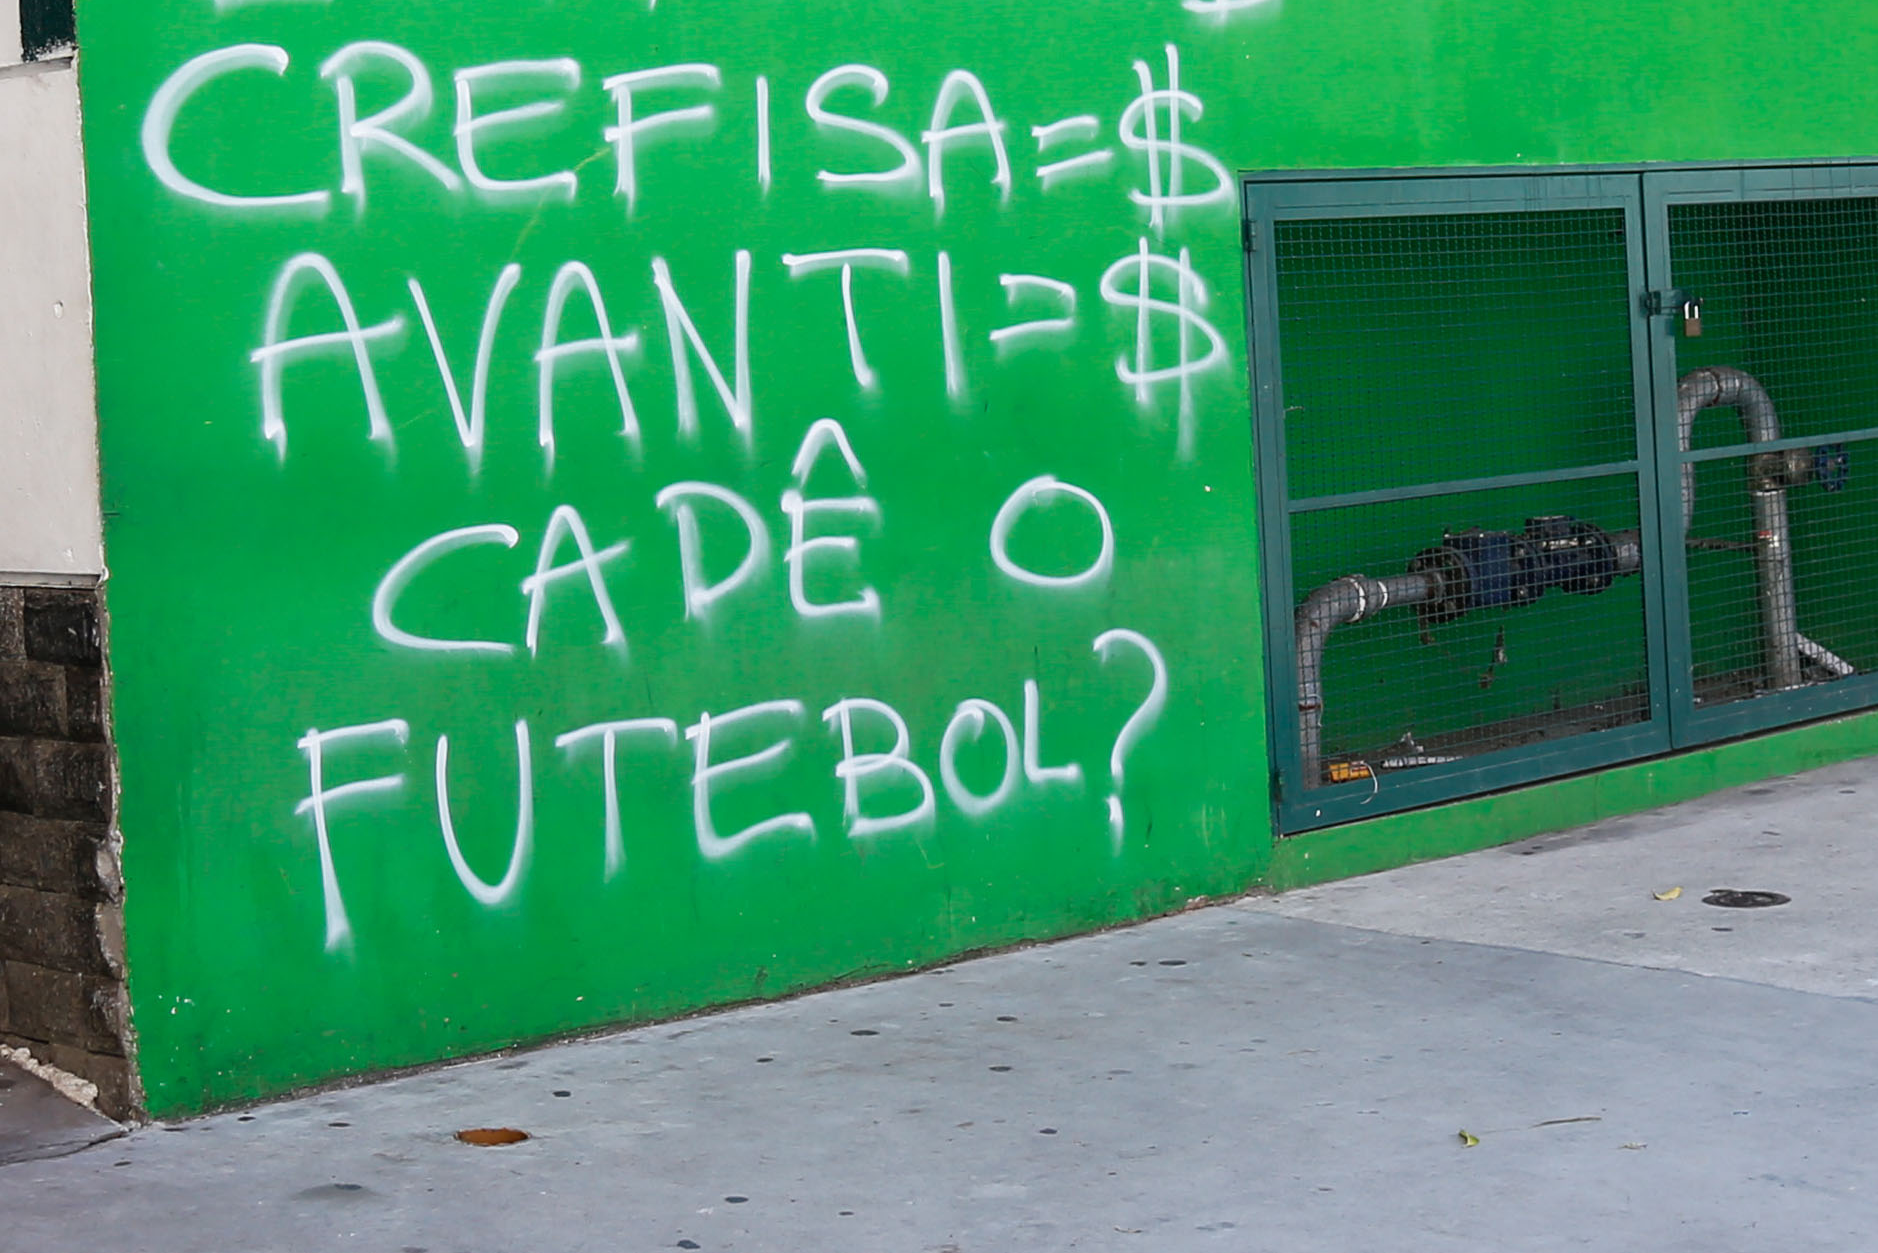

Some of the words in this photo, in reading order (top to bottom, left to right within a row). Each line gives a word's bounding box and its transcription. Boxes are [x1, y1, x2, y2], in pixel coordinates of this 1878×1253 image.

[371, 416, 884, 662] CADÊ
[988, 474, 1117, 590] O
[294, 628, 1170, 951] FUTEBOL?
